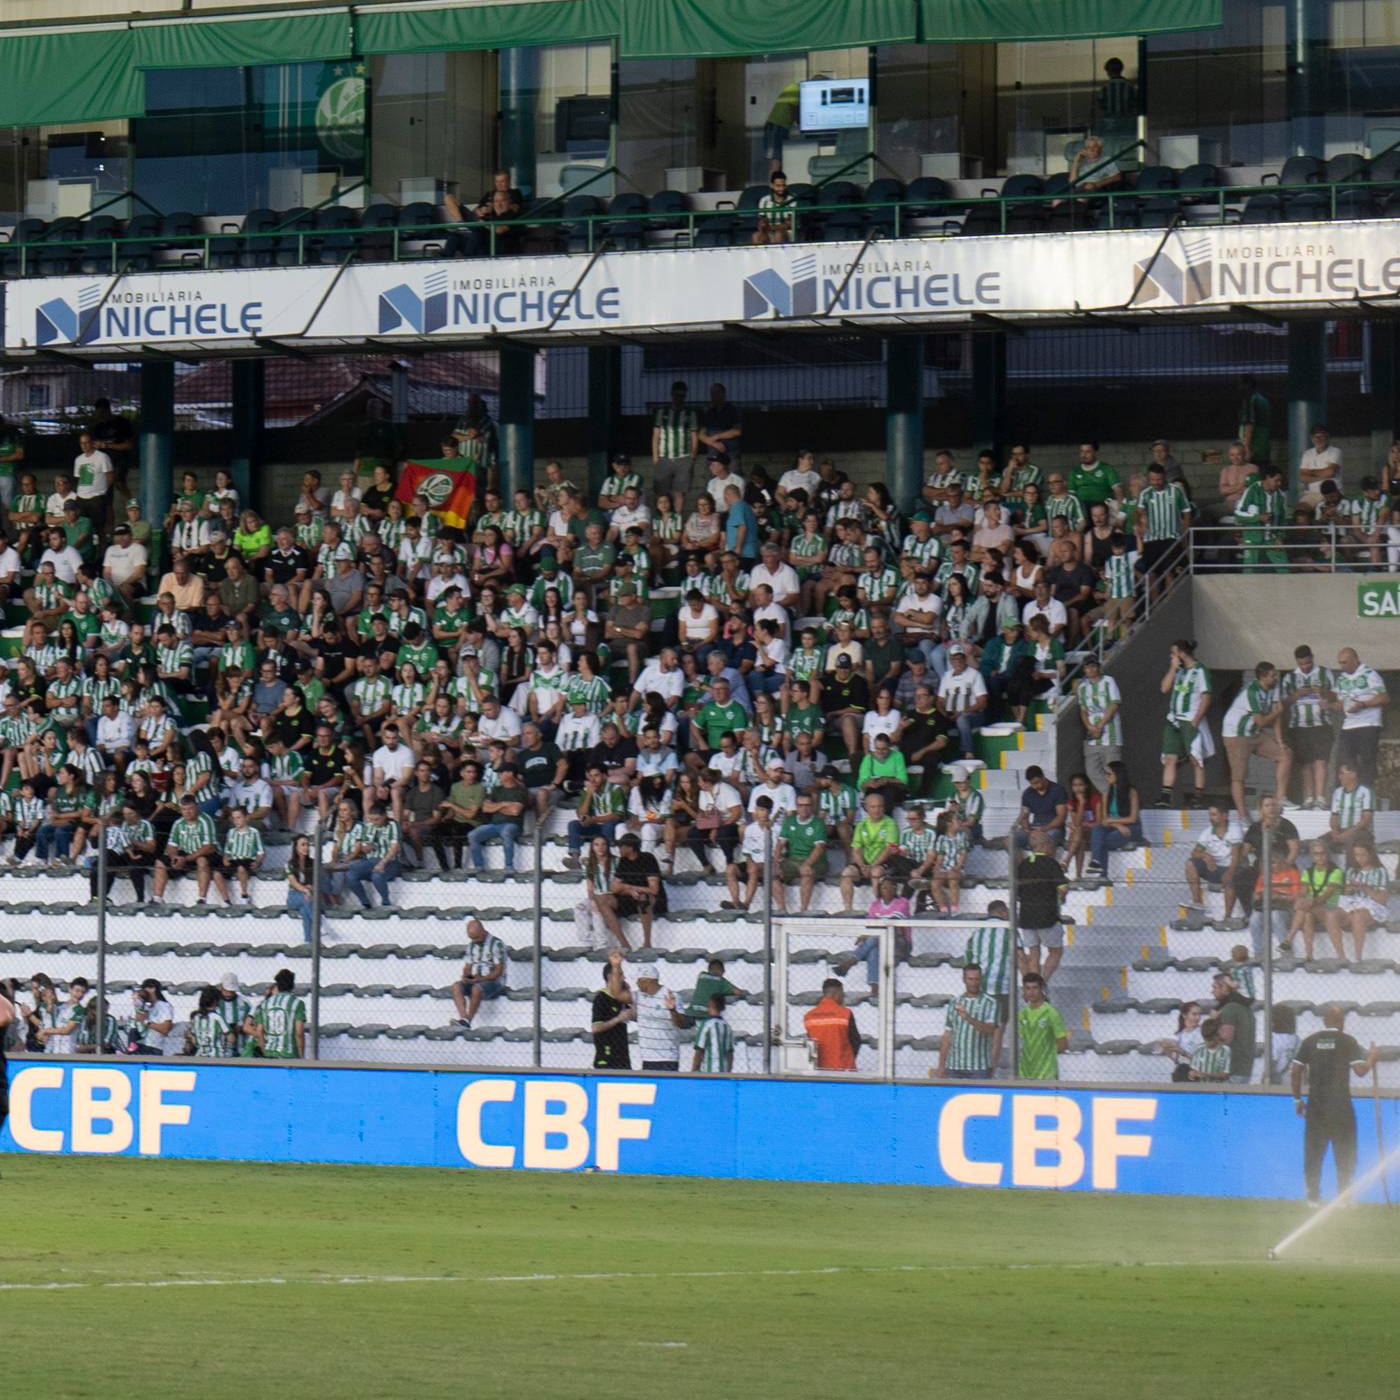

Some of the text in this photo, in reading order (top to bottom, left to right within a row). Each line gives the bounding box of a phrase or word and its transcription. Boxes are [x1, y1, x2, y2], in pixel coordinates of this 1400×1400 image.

[822, 273, 1000, 311] NICHELE
[1219, 257, 1400, 296] NICHELE
[106, 302, 263, 337] NICHELE
[453, 287, 620, 325] NICHELE
[9, 1067, 196, 1155] CBF
[457, 1079, 657, 1171] CBF
[938, 1093, 1157, 1189] CBF
